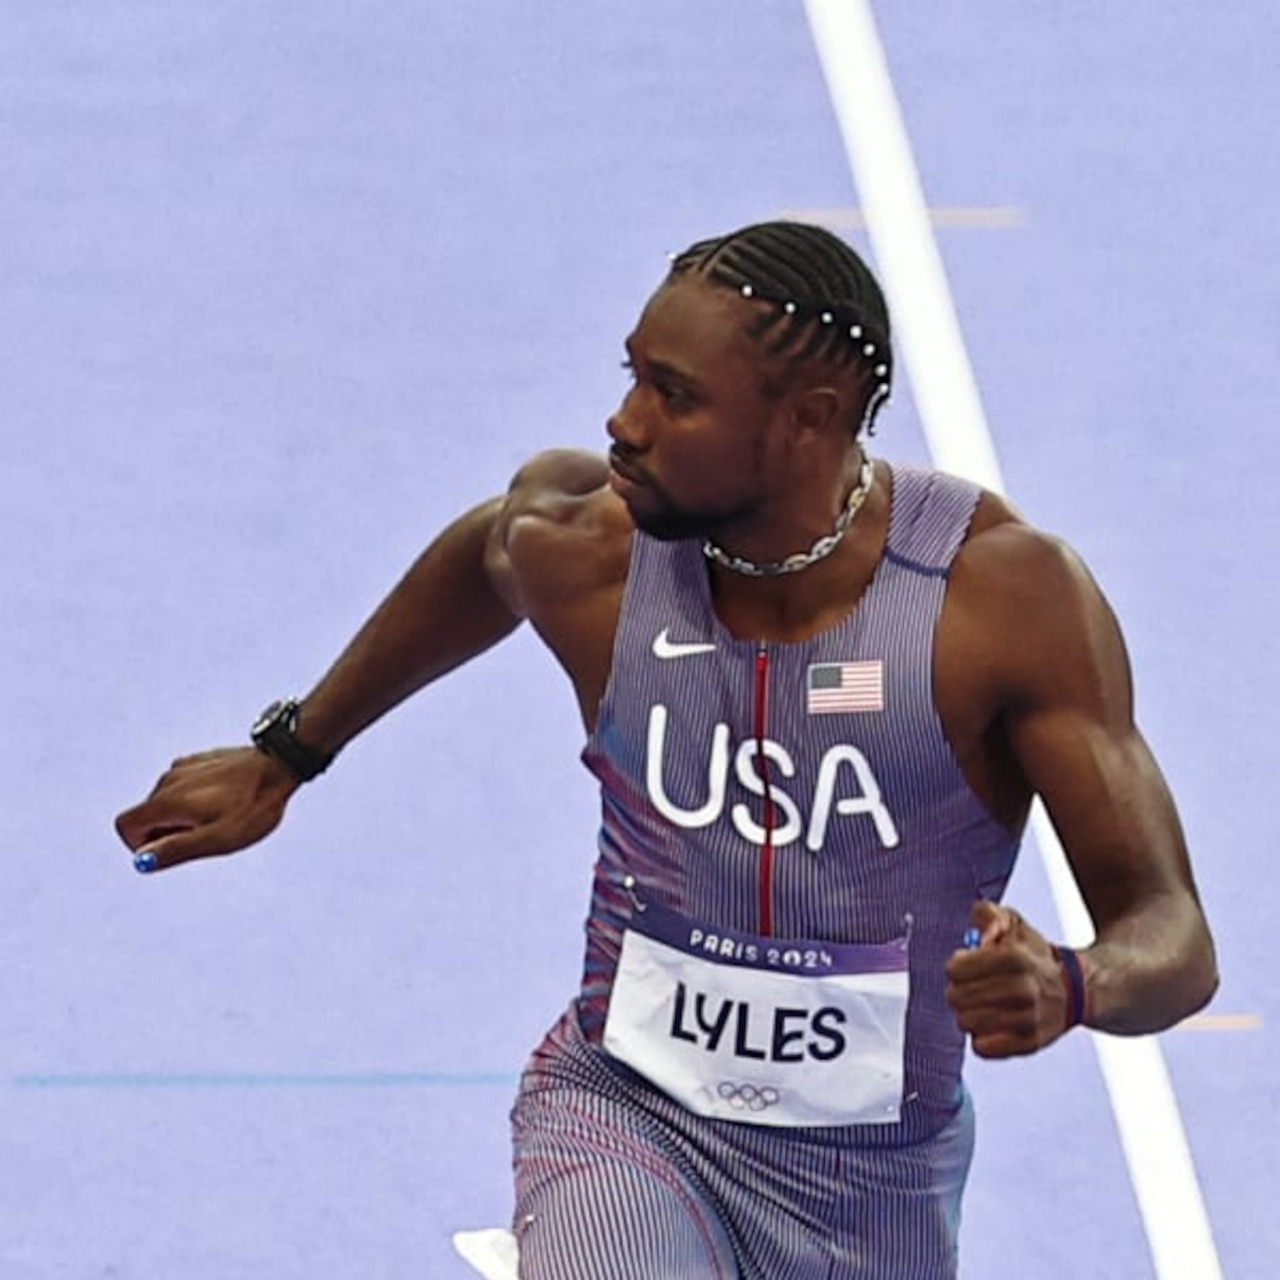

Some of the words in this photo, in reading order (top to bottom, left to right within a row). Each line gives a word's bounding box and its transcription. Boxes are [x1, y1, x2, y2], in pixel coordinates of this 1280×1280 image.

[646, 704, 899, 851] USA
[690, 929, 758, 962] PARIS
[767, 949, 832, 967] 2024
[670, 982, 847, 1063] LYLES
